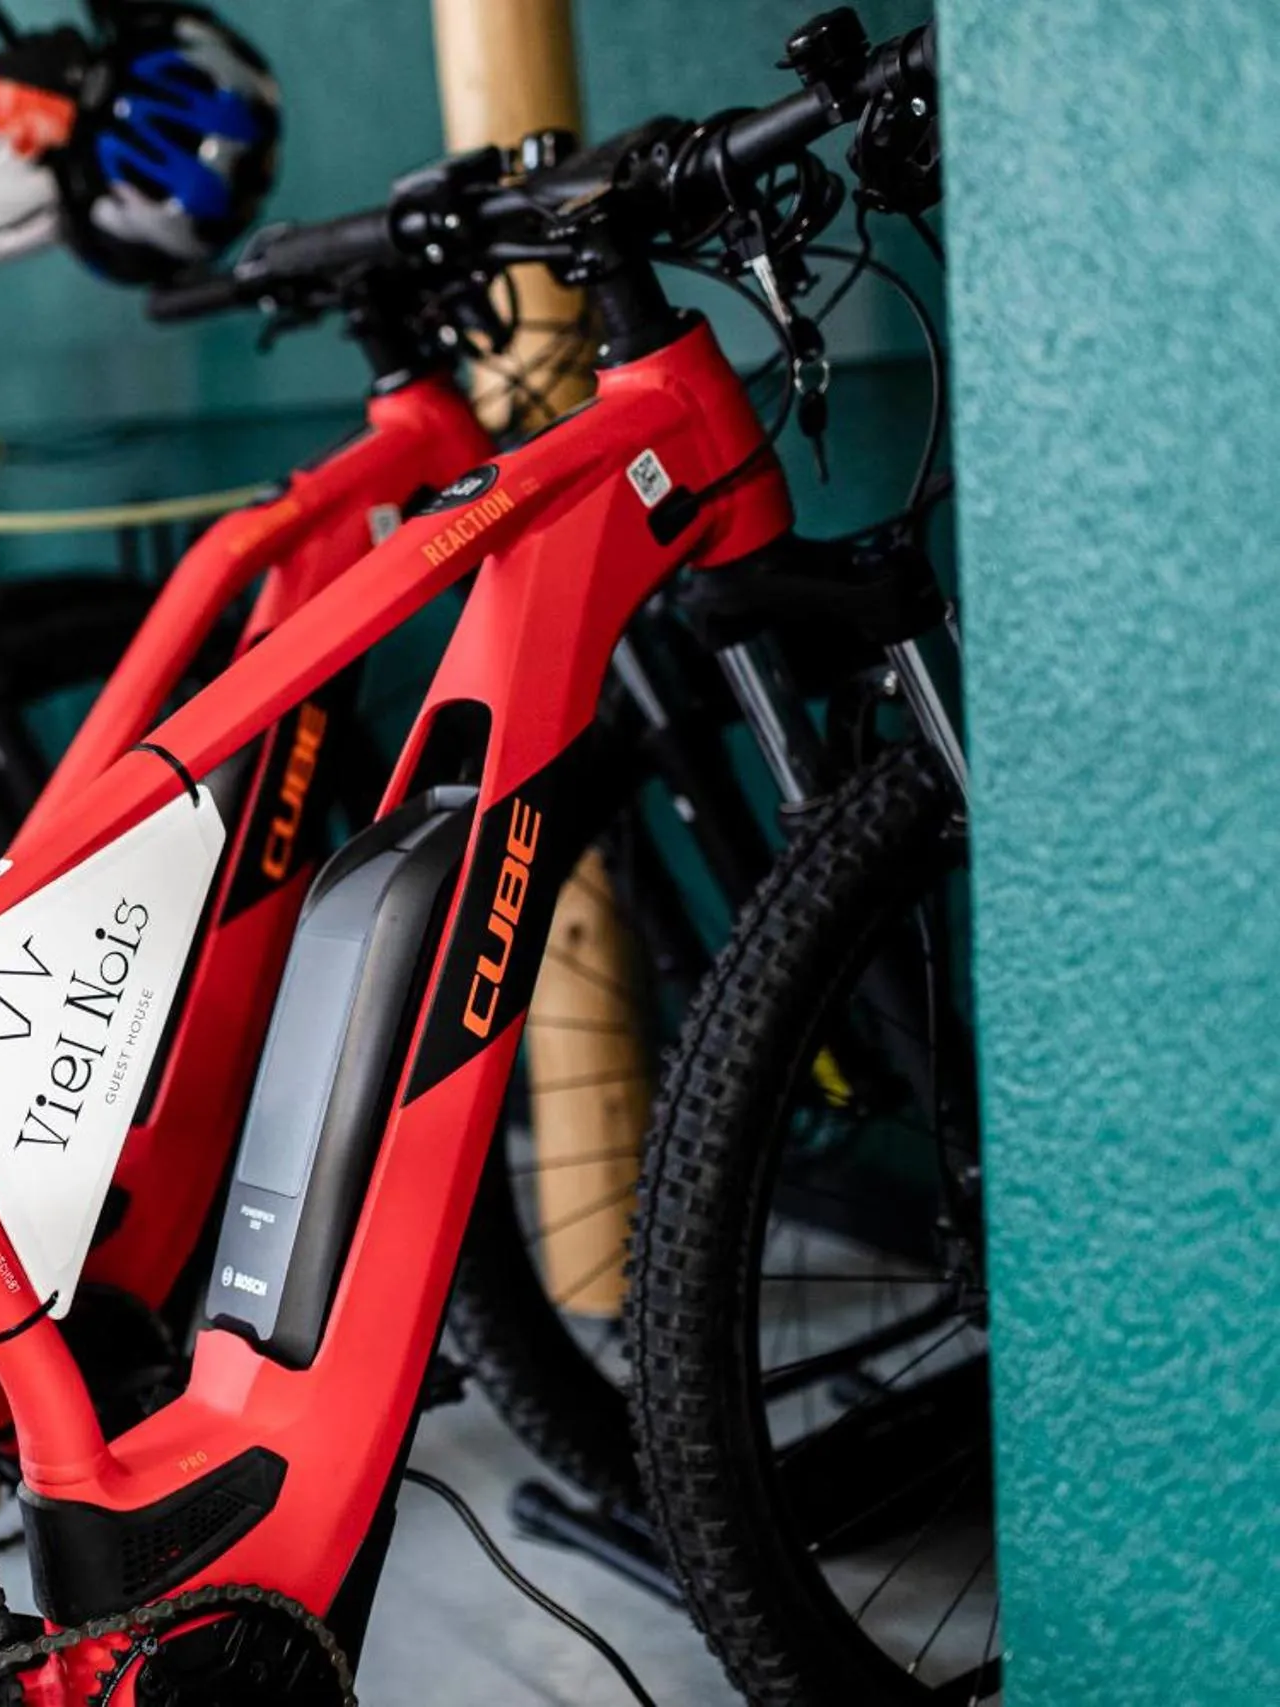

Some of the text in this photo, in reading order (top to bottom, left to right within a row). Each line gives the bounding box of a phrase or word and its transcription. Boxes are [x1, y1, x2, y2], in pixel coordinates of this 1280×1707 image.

[422, 488, 515, 567] REACTION
[463, 797, 542, 1039] CUBE
[14, 897, 149, 1152] Viel Nois
[105, 988, 155, 1106] GUEST HOUSE
[233, 1271, 268, 1297] BOSCH
[179, 1449, 208, 1473] PRO
